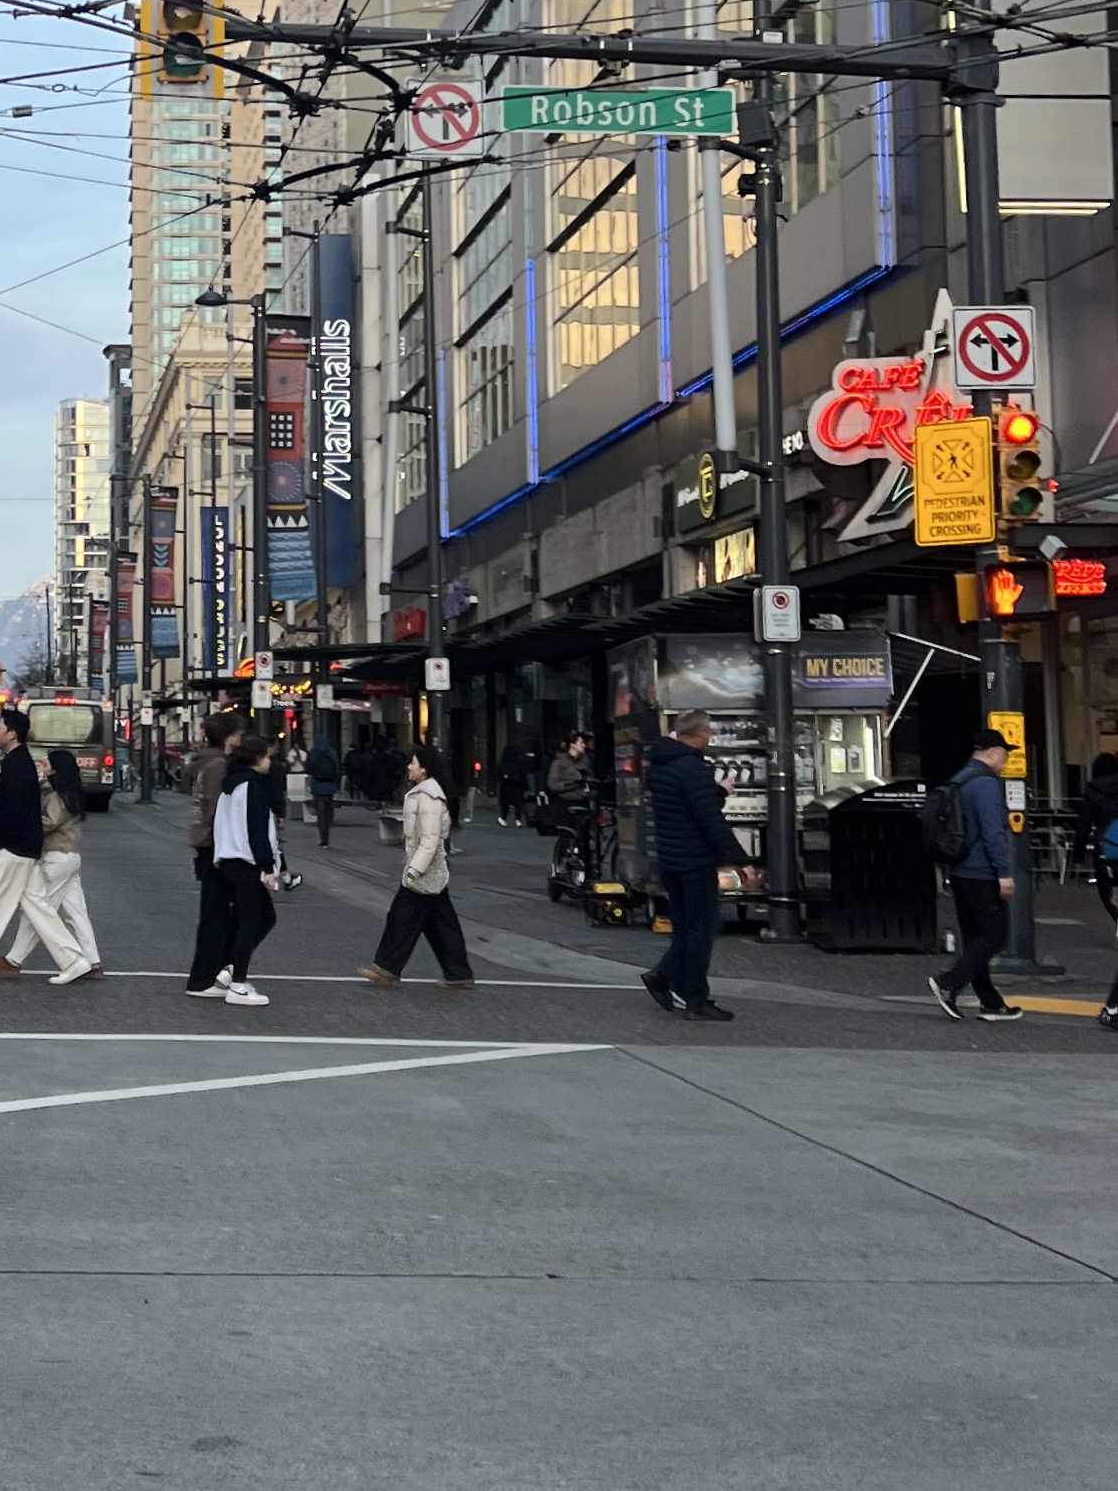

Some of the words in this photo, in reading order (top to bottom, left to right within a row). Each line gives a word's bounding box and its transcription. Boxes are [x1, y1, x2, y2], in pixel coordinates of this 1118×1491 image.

[532, 94, 657, 127] Robson
[673, 96, 705, 128] St
[838, 359, 925, 392] CAFÉ
[319, 319, 352, 500] Marshalls
[923, 496, 986, 510] PEDESTRIAN
[931, 509, 978, 523] PRIORITY
[929, 523, 982, 538] CROSSING
[806, 658, 829, 677] MY
[832, 657, 885, 677] CHOICE
